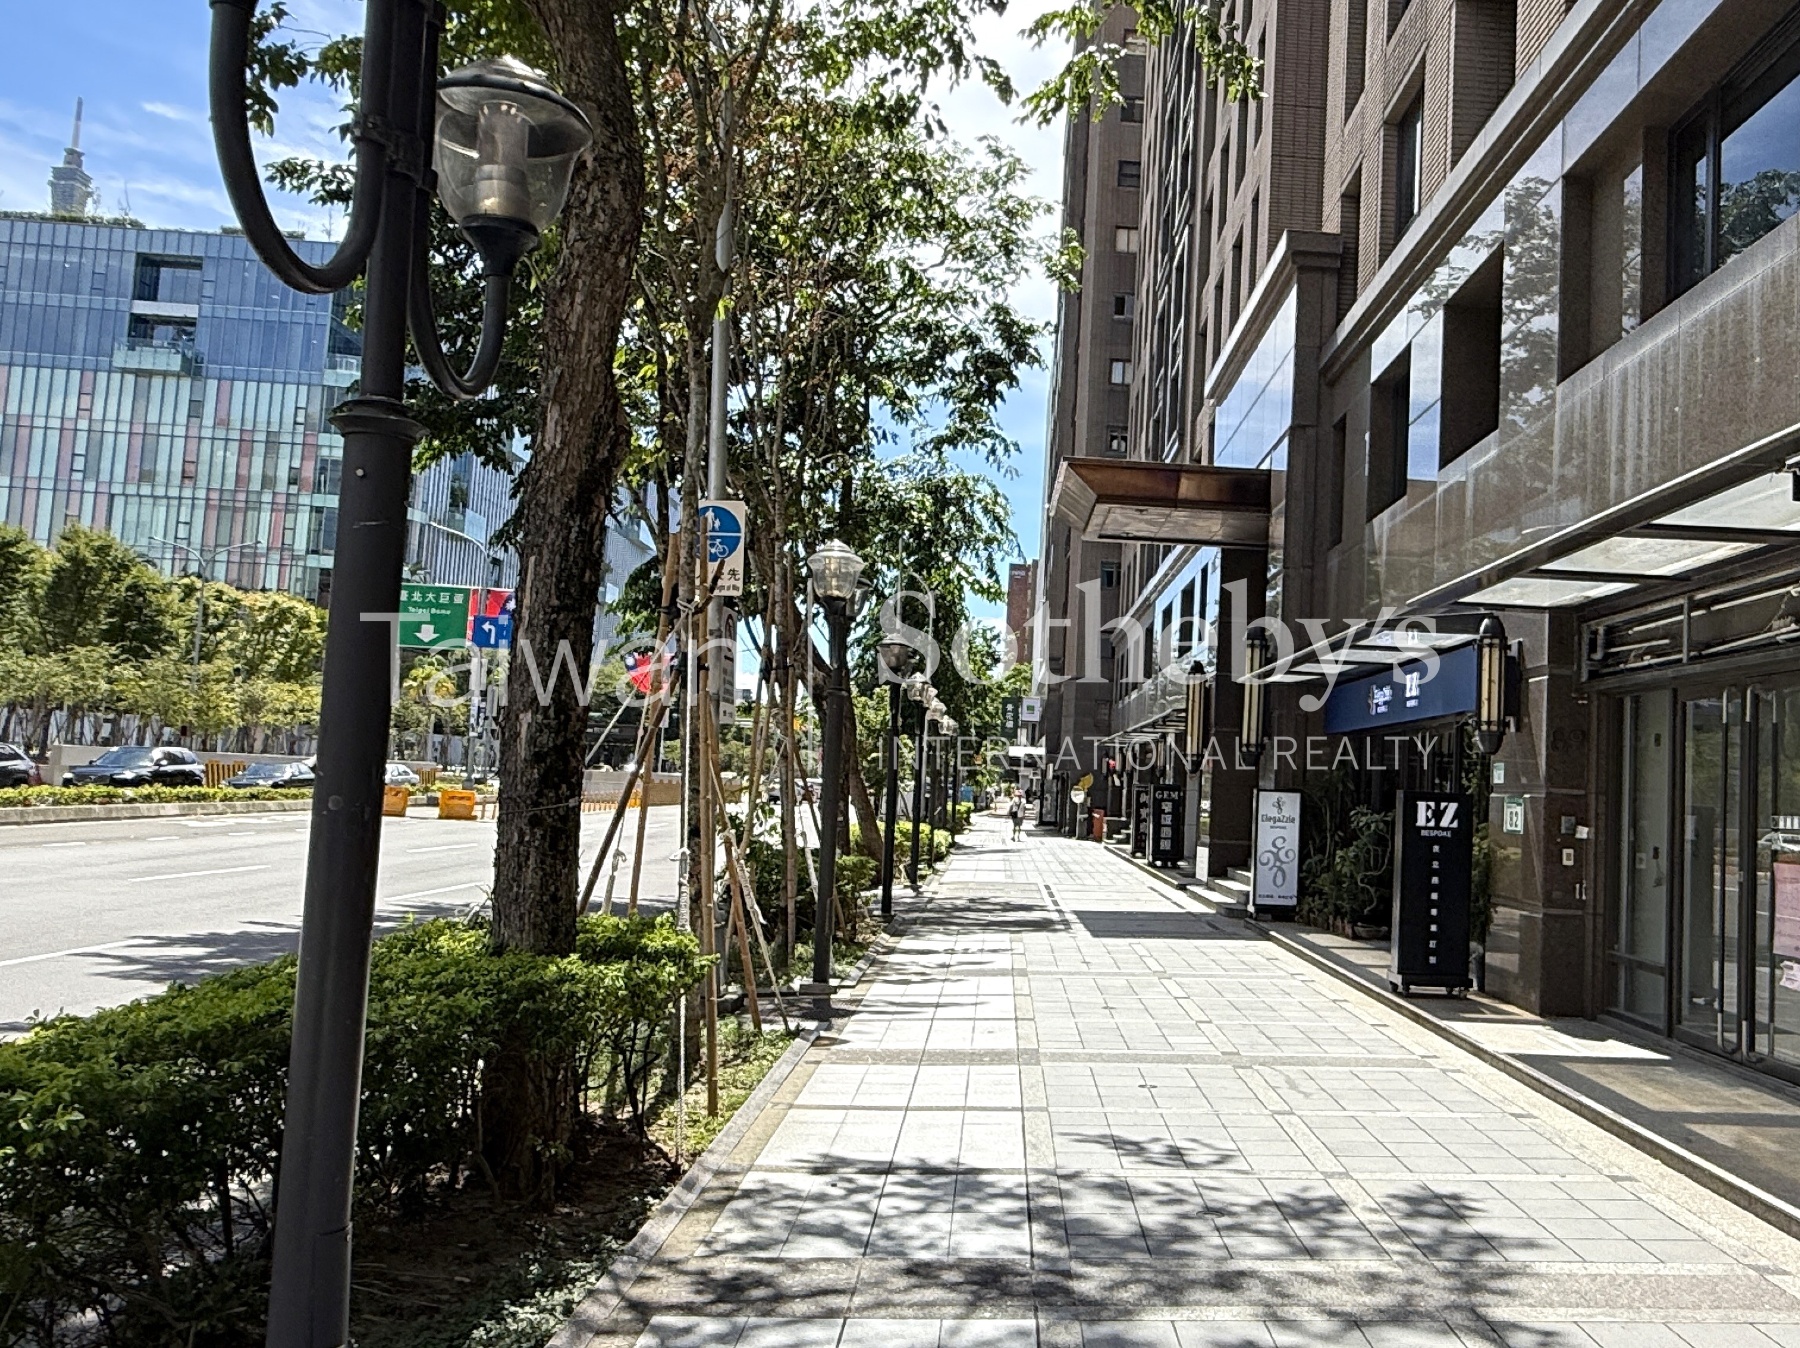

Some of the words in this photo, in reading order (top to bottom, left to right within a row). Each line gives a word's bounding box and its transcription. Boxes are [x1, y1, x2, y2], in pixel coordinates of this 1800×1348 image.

[1155, 790, 1179, 800] GEM
[1415, 801, 1459, 828] EZ
[1420, 829, 1452, 838] BESPOKE
